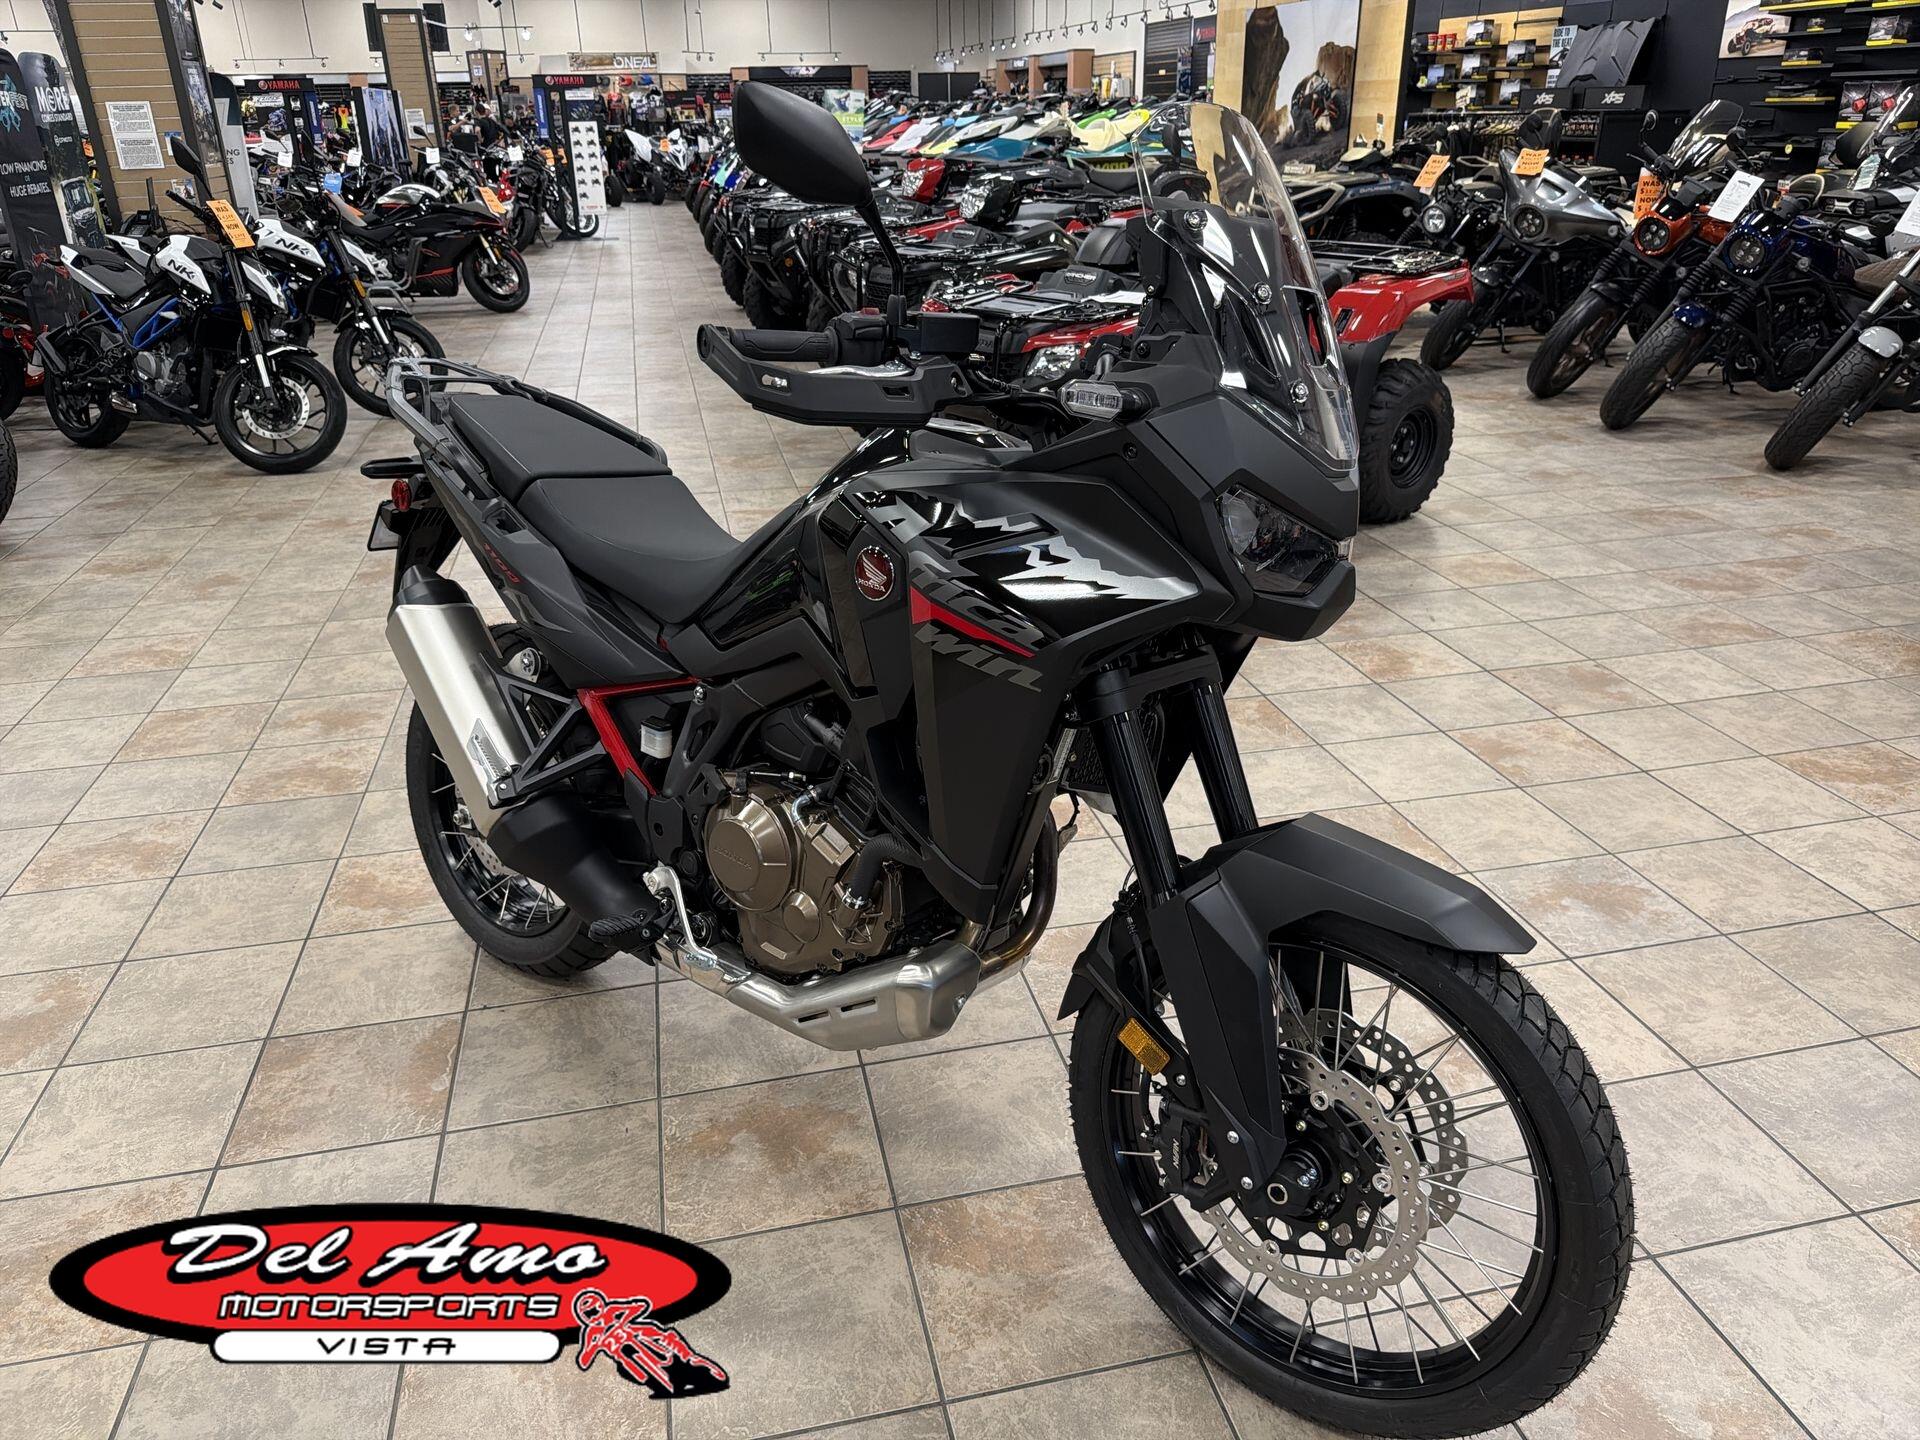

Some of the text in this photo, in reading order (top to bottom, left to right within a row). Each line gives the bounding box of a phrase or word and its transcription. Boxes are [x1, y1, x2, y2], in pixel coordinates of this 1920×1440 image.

[1553, 38, 1573, 48] THE BEAT
[267, 80, 300, 90] YAMAHA
[553, 76, 585, 85] YAMAHA
[35, 86, 70, 112] MORE
[1533, 92, 1555, 105] XPS
[1601, 91, 1625, 104] XPS
[54, 112, 73, 122] STANDARD
[0, 160, 47, 175] LOW FINANCING
[10, 185, 27, 198] HUGE
[167, 259, 195, 280] NK
[858, 578, 886, 592] HONDA
